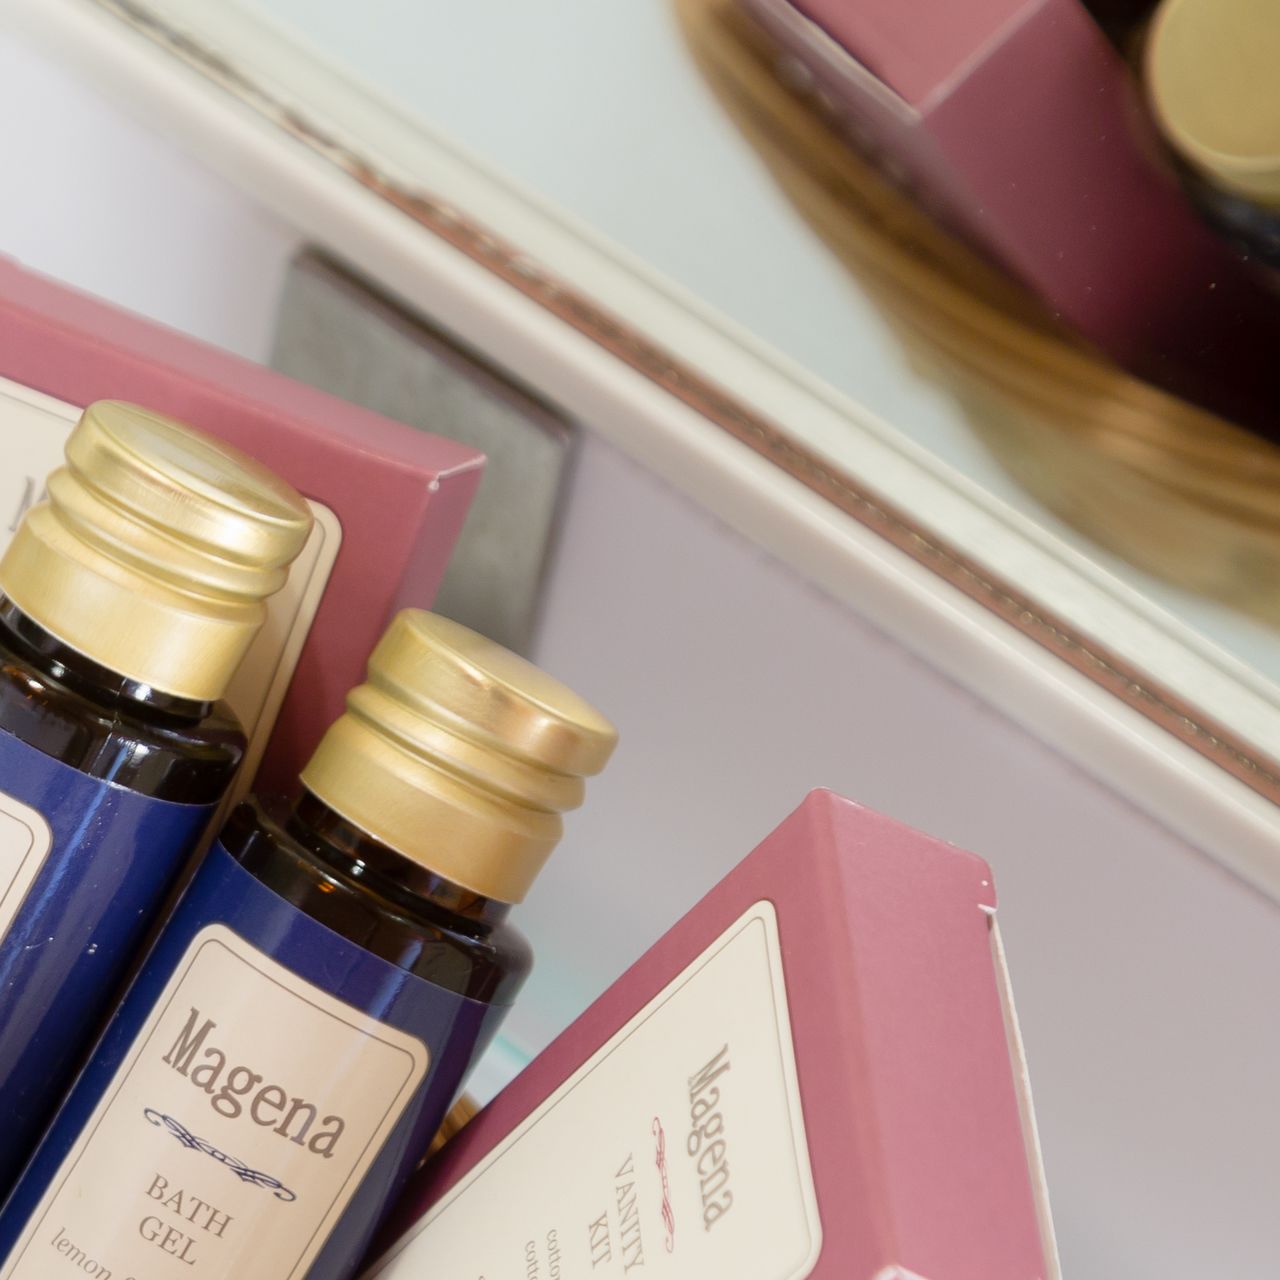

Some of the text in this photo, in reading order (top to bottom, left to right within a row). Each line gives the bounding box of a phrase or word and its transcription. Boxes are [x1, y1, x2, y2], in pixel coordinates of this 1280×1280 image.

[162, 1006, 346, 1159] Magena
[687, 1042, 734, 1233] Magena
[138, 1215, 198, 1267] GEL
[144, 1173, 235, 1239] BATH
[589, 1210, 612, 1270] KIT
[614, 1152, 644, 1275] VANITY
